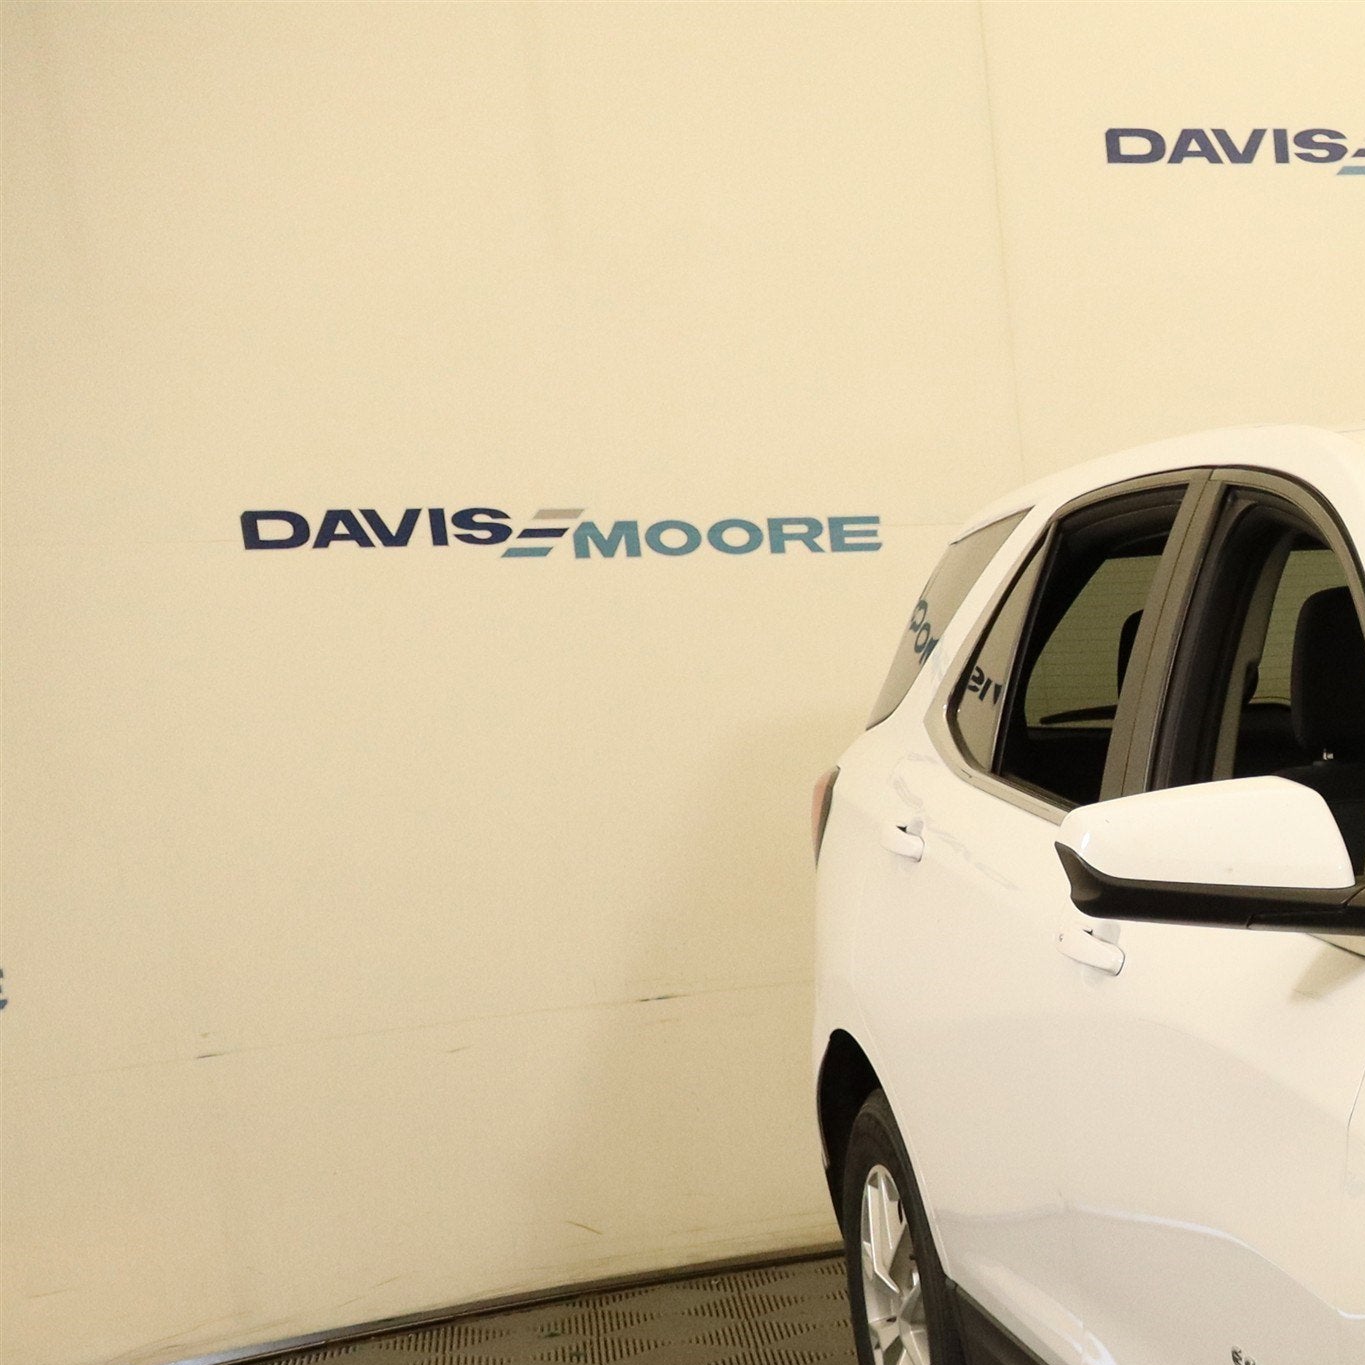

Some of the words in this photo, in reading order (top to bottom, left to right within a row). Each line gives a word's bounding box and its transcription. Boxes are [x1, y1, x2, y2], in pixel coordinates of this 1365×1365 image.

[1104, 127, 1349, 165] DAVIS
[239, 506, 515, 552] DAVIS
[572, 515, 884, 560] MOORE
